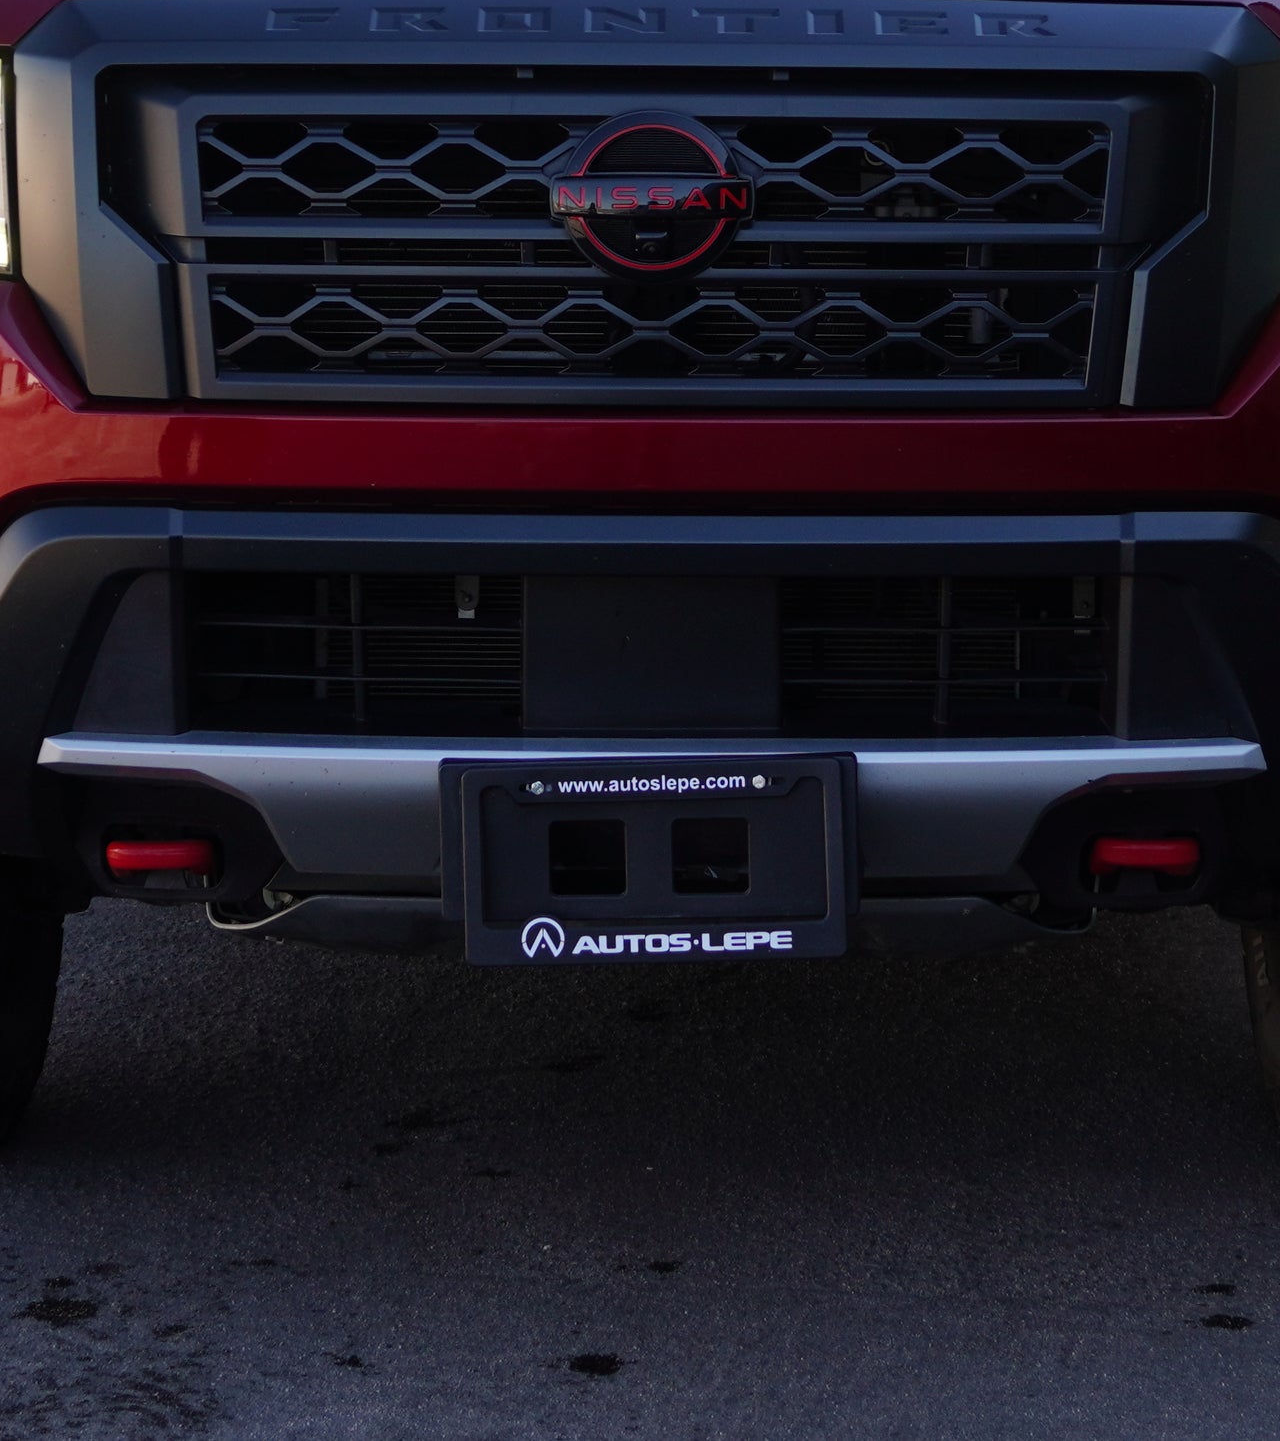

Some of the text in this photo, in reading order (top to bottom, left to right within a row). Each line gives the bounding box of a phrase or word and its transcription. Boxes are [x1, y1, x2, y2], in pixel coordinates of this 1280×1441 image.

[266, 5, 1059, 38] FRONTIER
[557, 185, 748, 211] NISSAN
[558, 774, 746, 795] www.autoslepe.com
